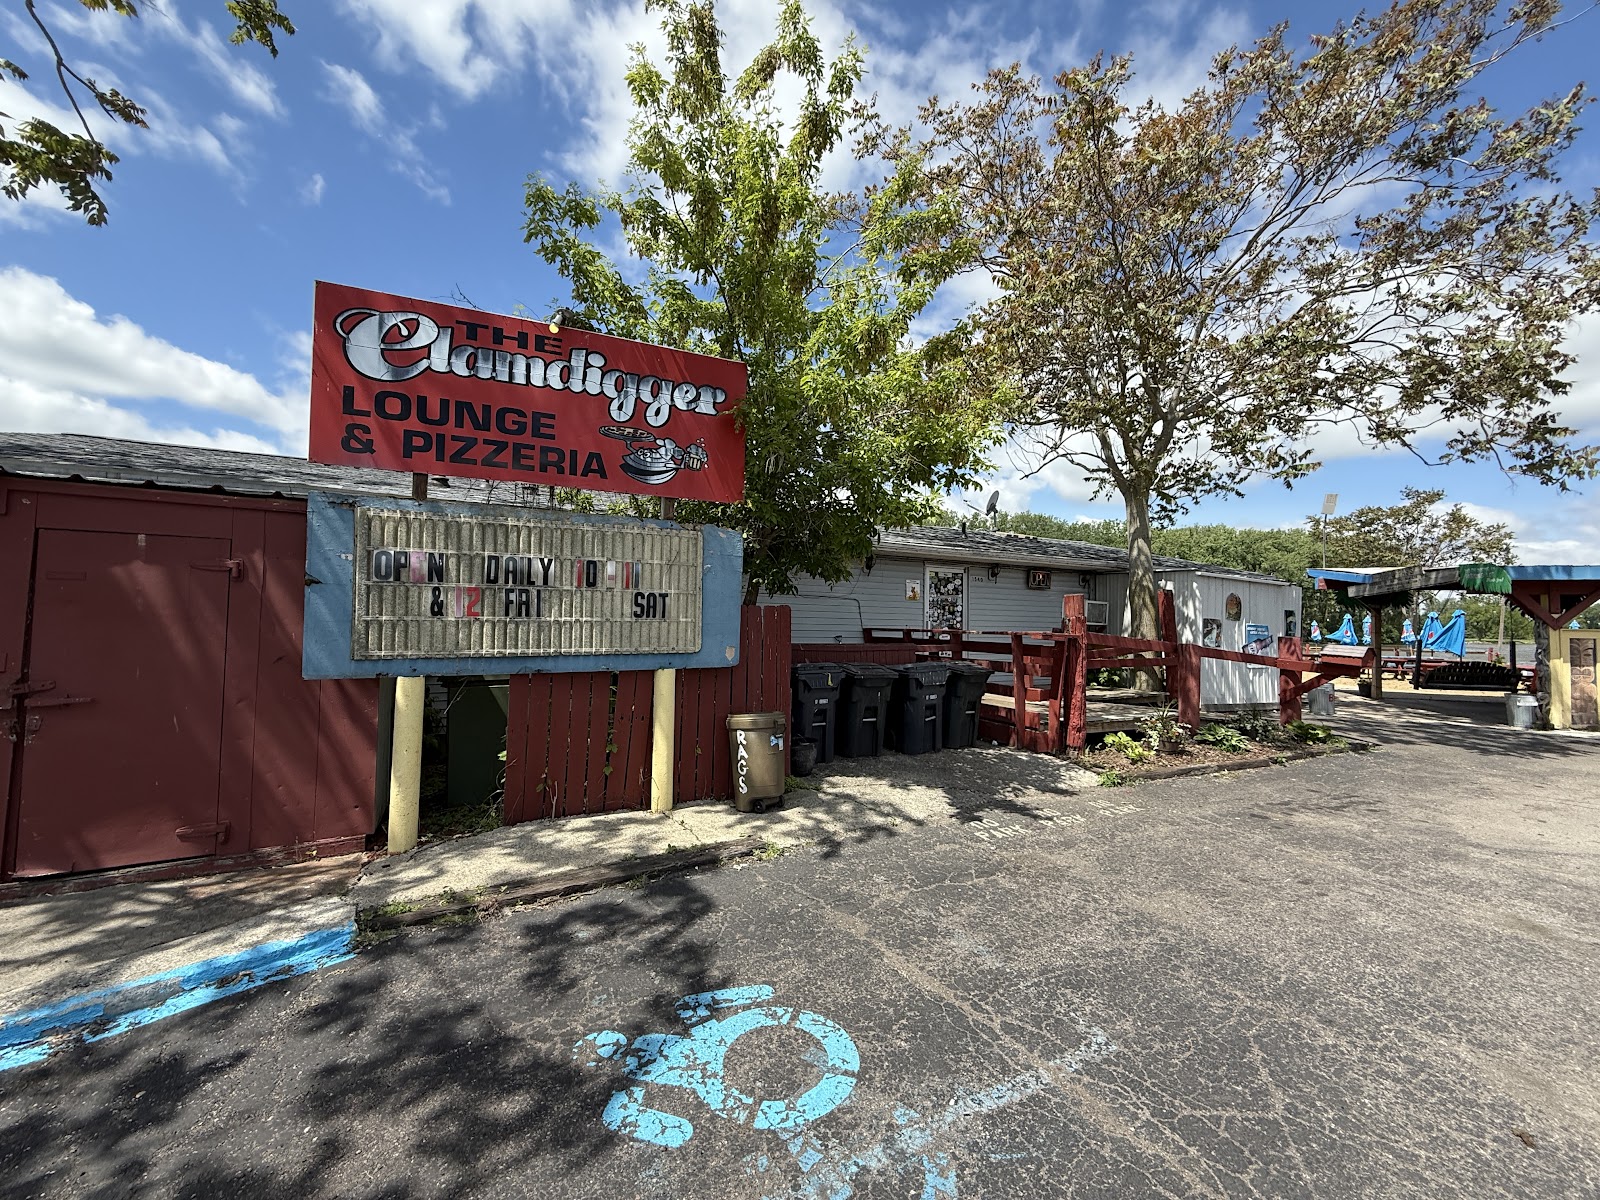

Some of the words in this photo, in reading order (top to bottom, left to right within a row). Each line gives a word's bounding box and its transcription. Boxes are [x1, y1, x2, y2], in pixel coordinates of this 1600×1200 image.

[455, 319, 563, 356] THE
[333, 307, 727, 429] Clamdigger
[342, 385, 557, 441] LOUNGE
[340, 422, 376, 456] &
[402, 429, 609, 480] PIZZERIA
[374, 550, 445, 584] OPEN
[485, 554, 554, 586] DAILY
[576, 559, 598, 588] 10
[430, 586, 445, 617] &
[455, 586, 481, 617] 12
[504, 588, 541, 618] FRI
[633, 592, 669, 619] SAT
[736, 729, 748, 794] RAGS
